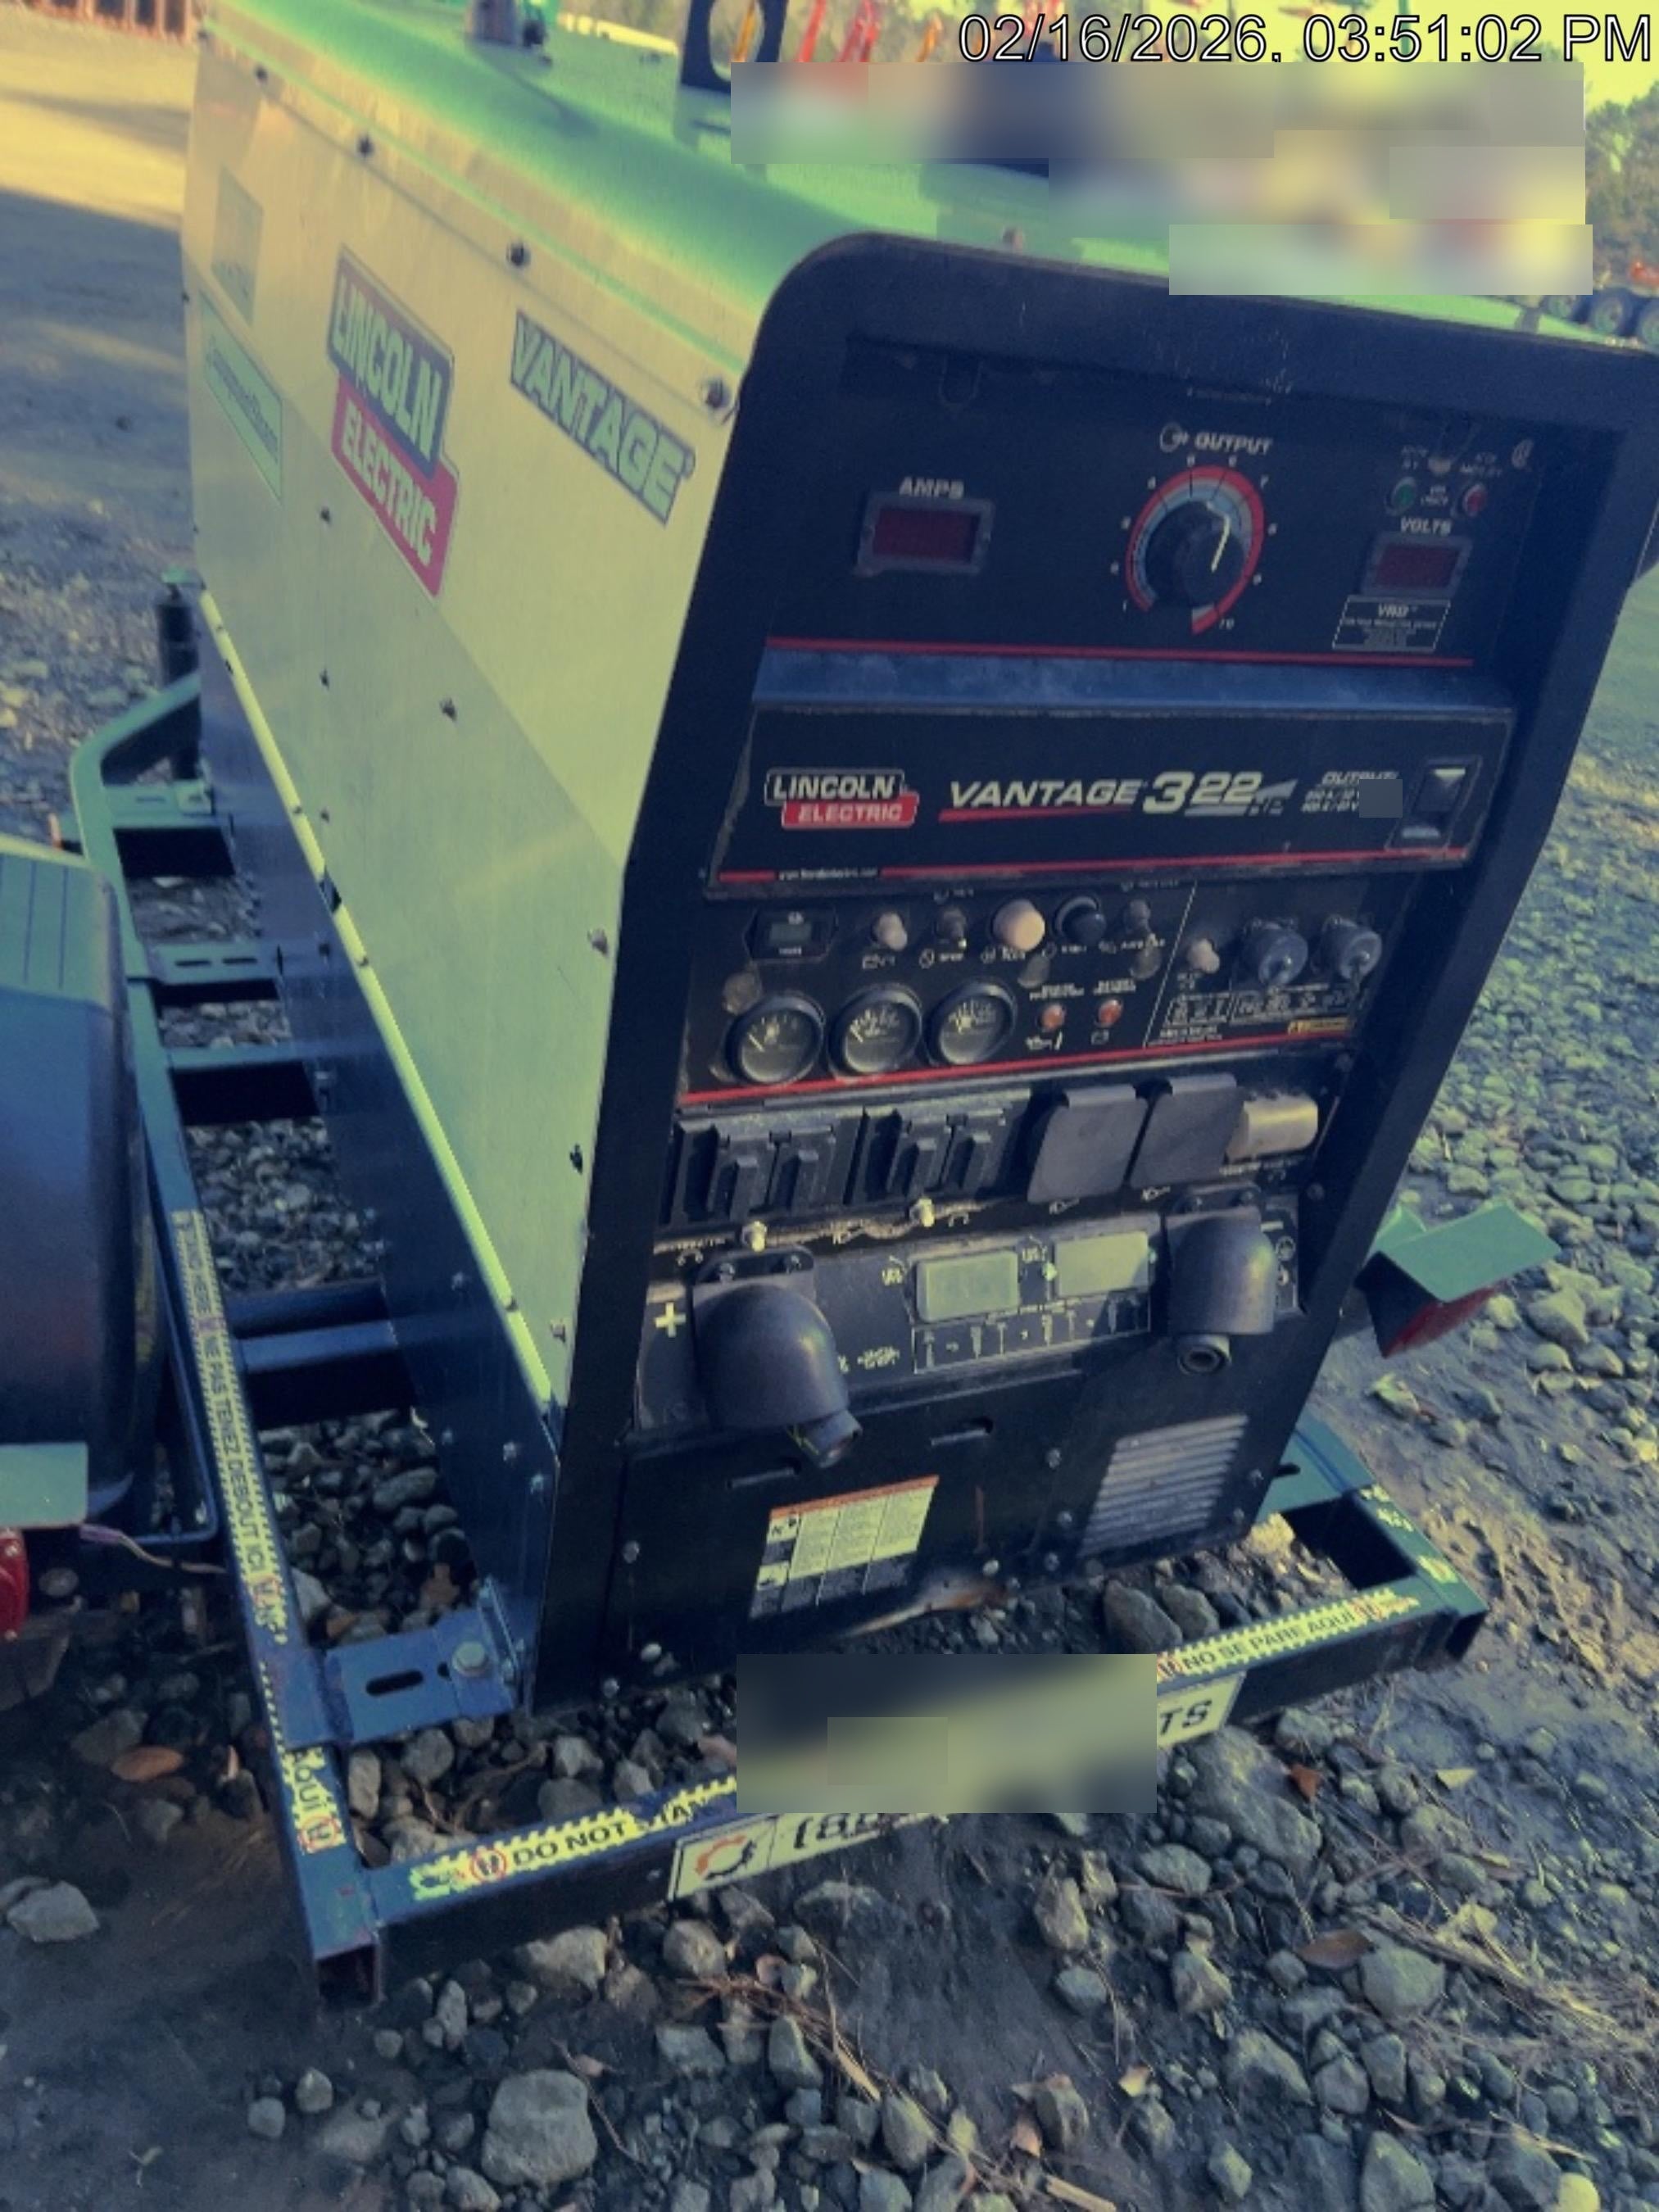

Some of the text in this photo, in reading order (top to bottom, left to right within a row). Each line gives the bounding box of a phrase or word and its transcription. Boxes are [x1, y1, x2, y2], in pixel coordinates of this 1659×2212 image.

[333, 277, 443, 460] LINCOLN
[510, 313, 687, 525] VANTAGE
[1194, 432, 1274, 455] OUTPUT
[340, 398, 437, 568] ELECTRIC
[899, 477, 965, 499] AMPS
[773, 775, 895, 800] LINCOLN
[950, 778, 1141, 809] VANTAGE
[1143, 770, 1262, 814] 322
[798, 804, 904, 823] ELECTRIC
[1182, 1649, 1217, 1670] NO
[1248, 1625, 1303, 1651] PARE
[1308, 1610, 1356, 1633] AQUI
[512, 1820, 628, 1867] DO NOT
